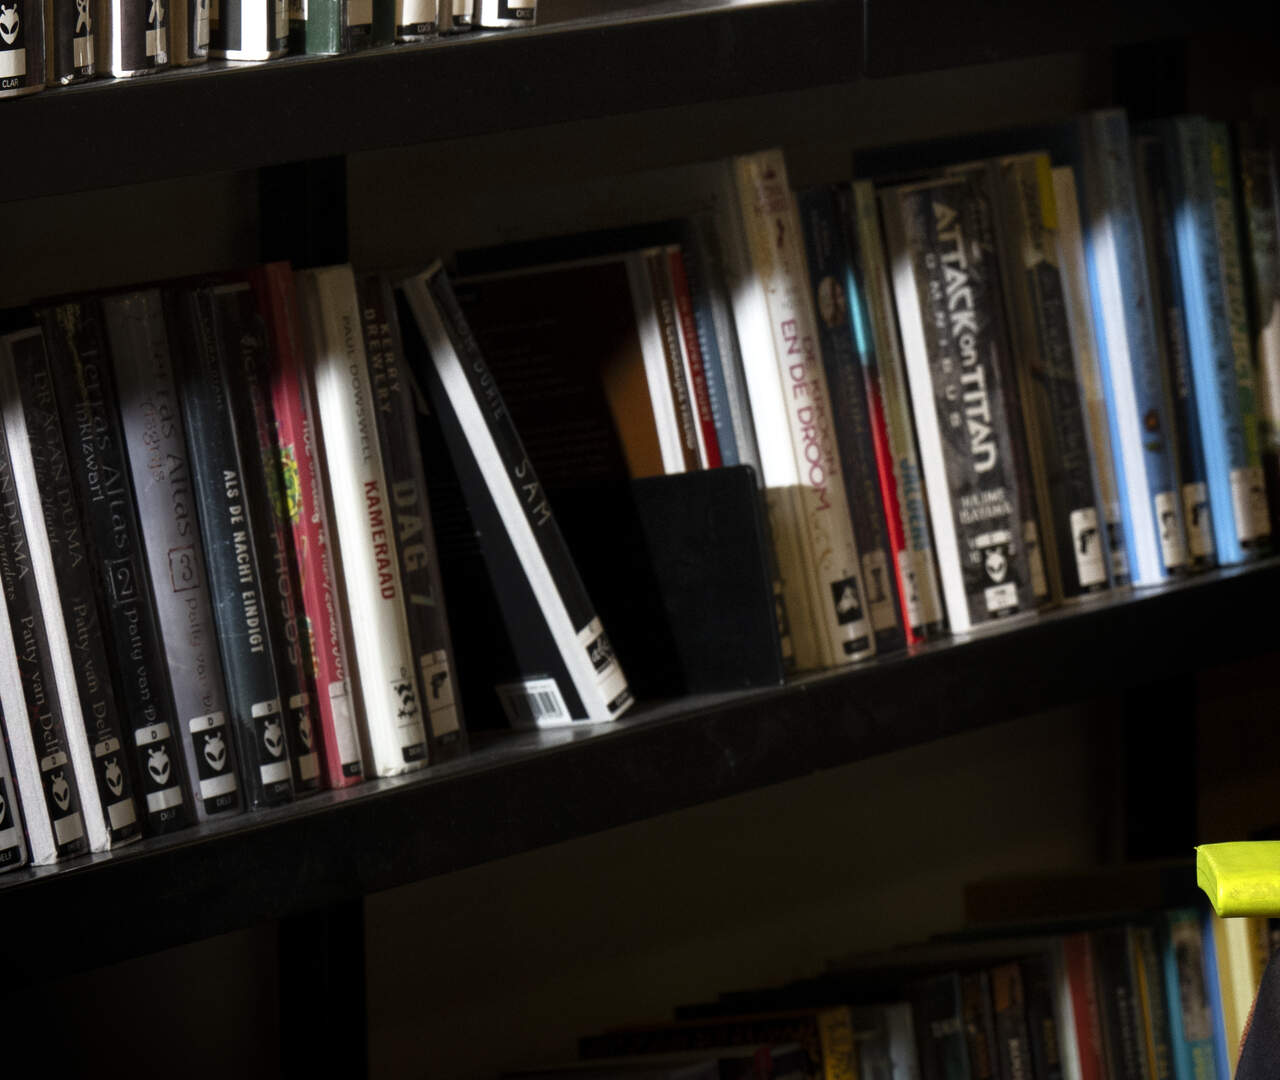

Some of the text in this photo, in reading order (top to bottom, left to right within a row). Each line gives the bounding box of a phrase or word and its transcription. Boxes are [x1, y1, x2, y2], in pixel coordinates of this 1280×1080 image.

[932, 202, 998, 473] ATTACK on TITAN
[780, 319, 832, 511] EN DE DROOM
[57, 487, 86, 569] DUMA
[102, 464, 129, 548] Altas
[514, 458, 552, 528] SAM
[3, 500, 30, 580] DUMA
[116, 571, 133, 596] 2
[179, 555, 194, 582] 3
[223, 469, 264, 654] ALS DE NACHT EINDIGT
[363, 480, 396, 601] KAMERAAD
[393, 481, 437, 609] DAG 7
[72, 597, 93, 651] Patty
[85, 659, 100, 695] van
[123, 609, 144, 662] Patty
[20, 615, 58, 758] Patty van Delf
